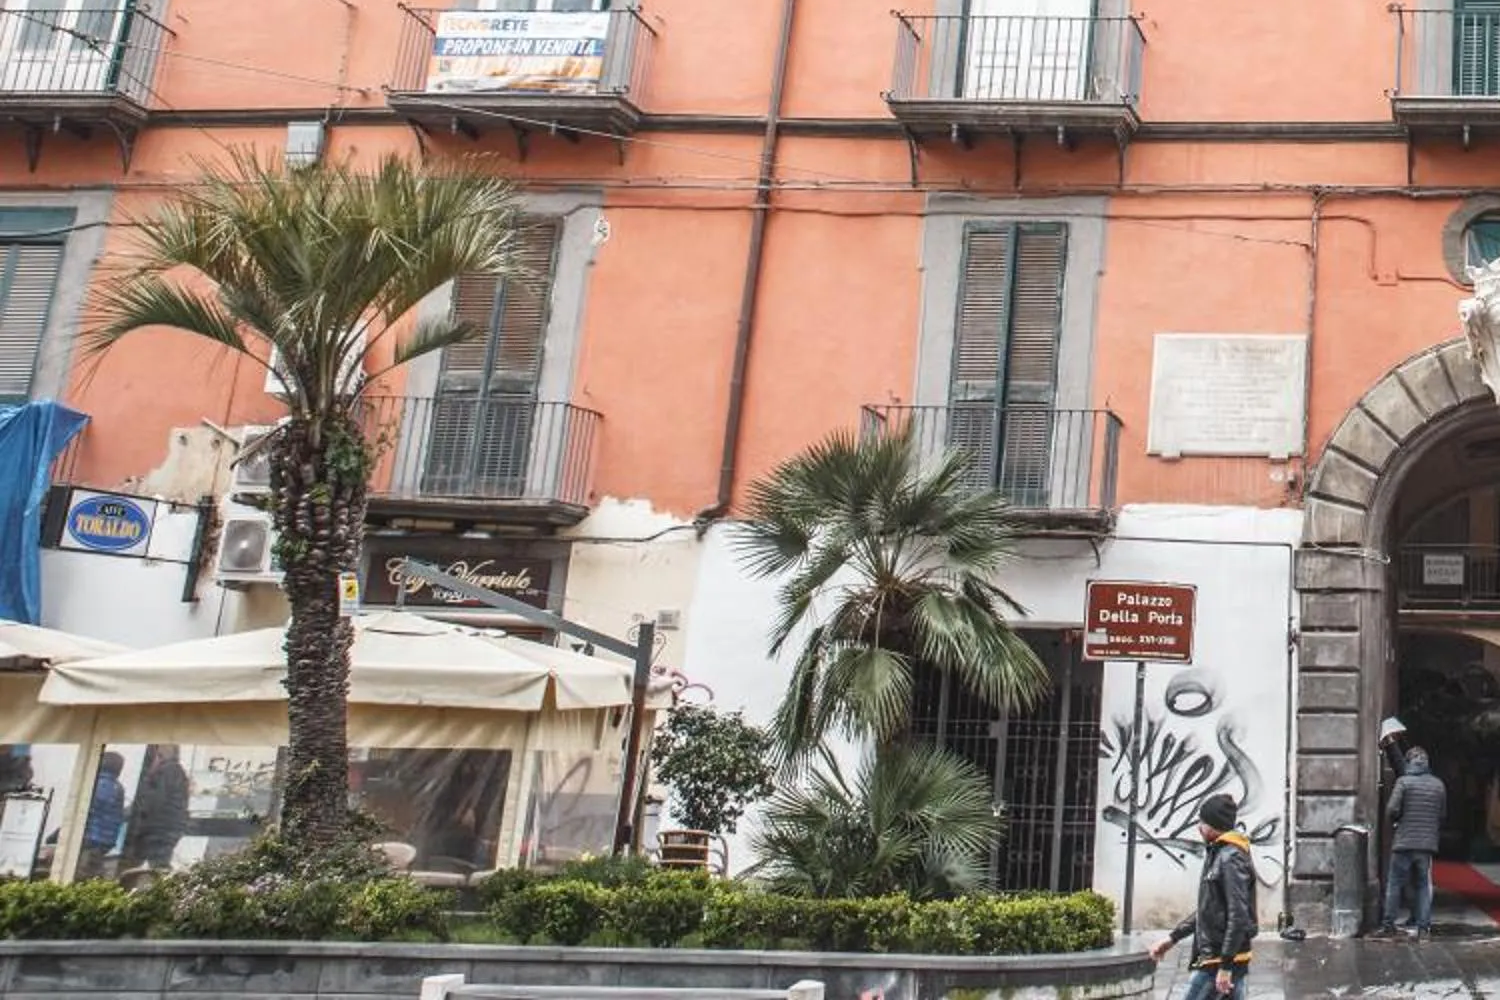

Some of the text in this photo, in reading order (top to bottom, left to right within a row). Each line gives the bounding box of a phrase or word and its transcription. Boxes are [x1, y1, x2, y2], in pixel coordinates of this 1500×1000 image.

[443, 38, 516, 56] PROPONE
[535, 38, 596, 55] VENDITA
[75, 513, 142, 537] TORALDO
[1117, 591, 1174, 608] Palazzo
[1099, 608, 1184, 626] Della Porta
